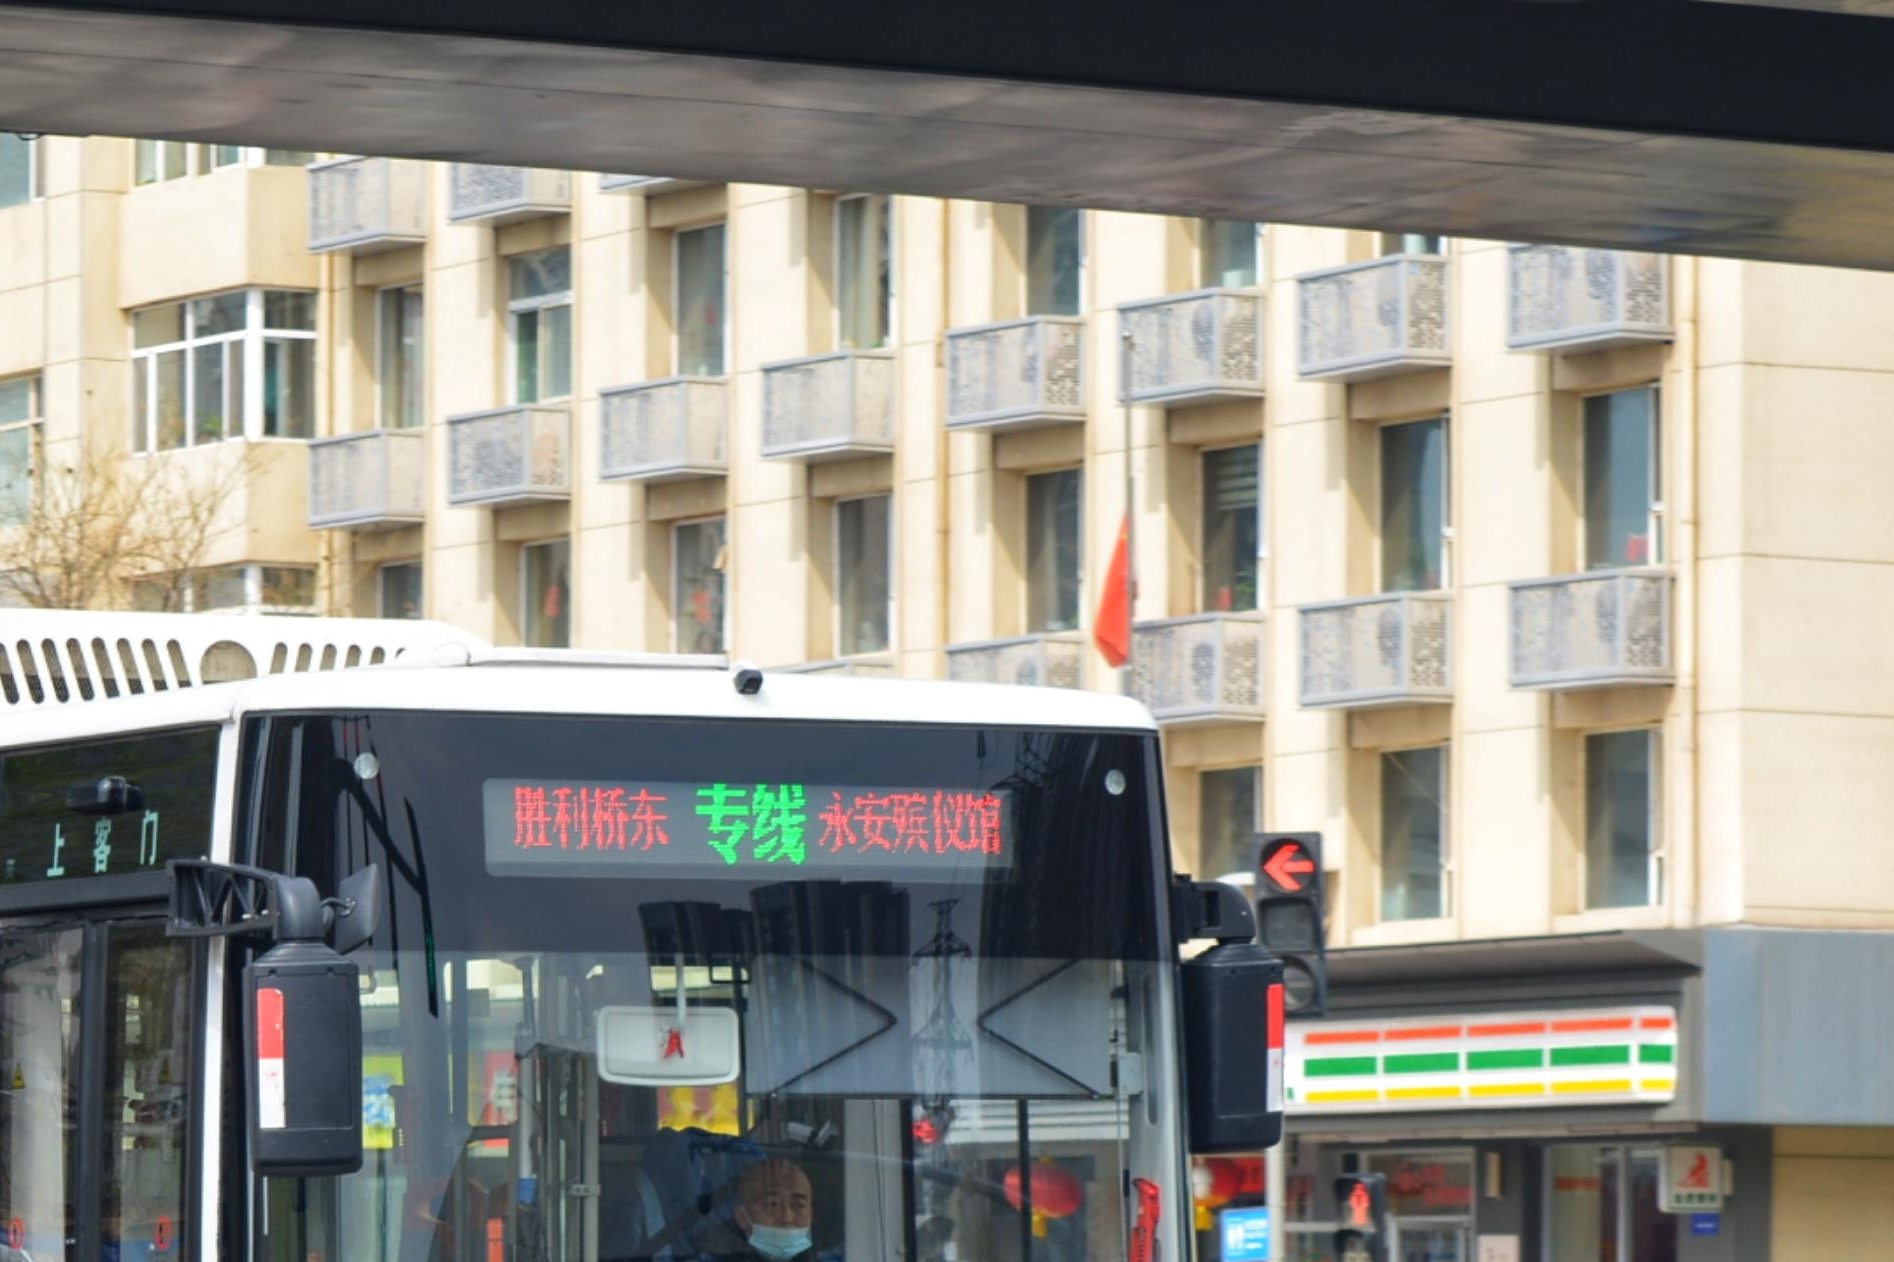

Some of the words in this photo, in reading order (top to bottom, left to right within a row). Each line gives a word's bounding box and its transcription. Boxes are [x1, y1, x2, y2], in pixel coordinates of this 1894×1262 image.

[46, 808, 159, 877] 上客门
[514, 786, 669, 851] 胜利桥东
[695, 783, 806, 864] 专线
[817, 790, 1002, 854] 永安殡仪馆
